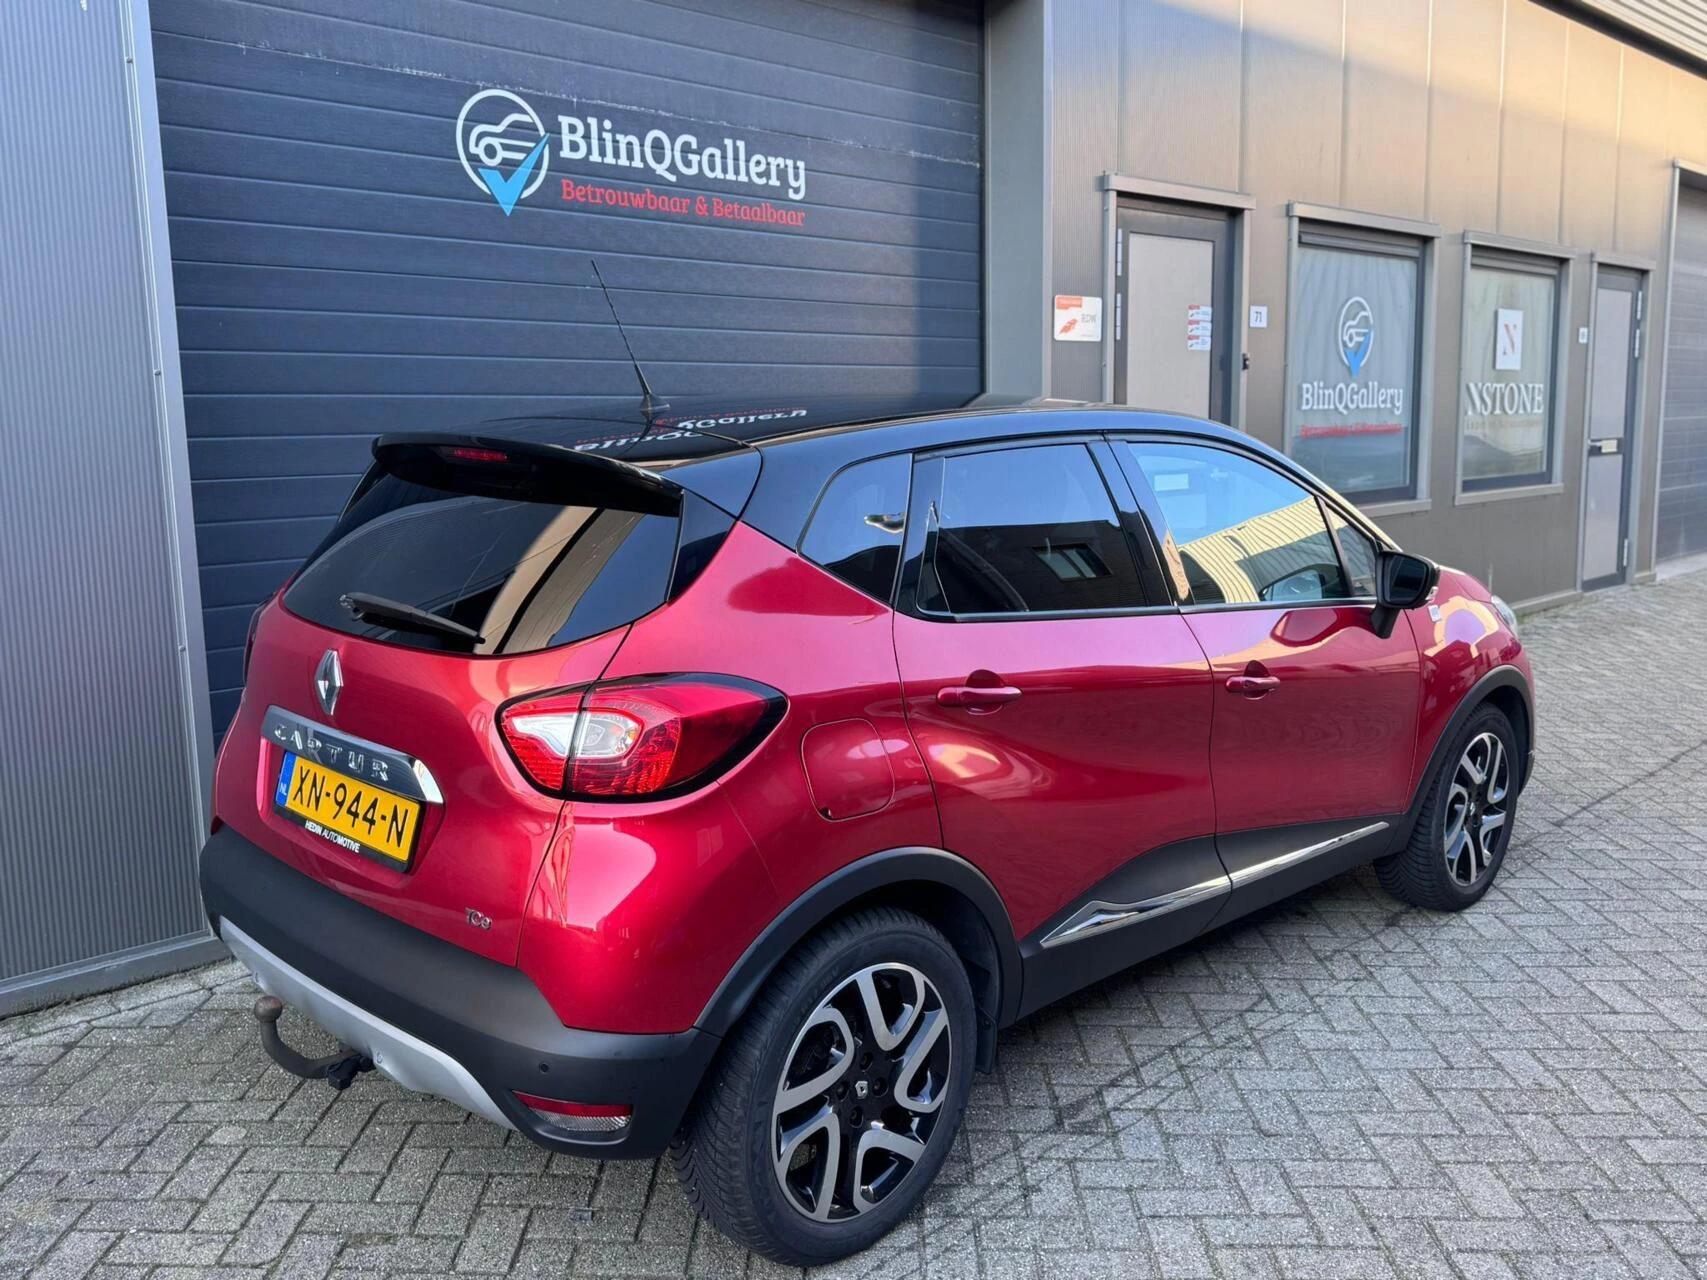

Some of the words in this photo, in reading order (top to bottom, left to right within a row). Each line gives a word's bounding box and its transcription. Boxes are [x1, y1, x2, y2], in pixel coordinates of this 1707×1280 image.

[557, 115, 806, 200] BlinQGallery
[561, 179, 691, 215] Betrouwbaar
[695, 197, 708, 216] &
[712, 199, 806, 226] Betaalbaar
[1301, 382, 1404, 415] BlinQGallery
[1467, 383, 1544, 415] NSTONE
[293, 766, 408, 848] XN-944-N
[321, 828, 360, 853] AUTOMOTIVE
